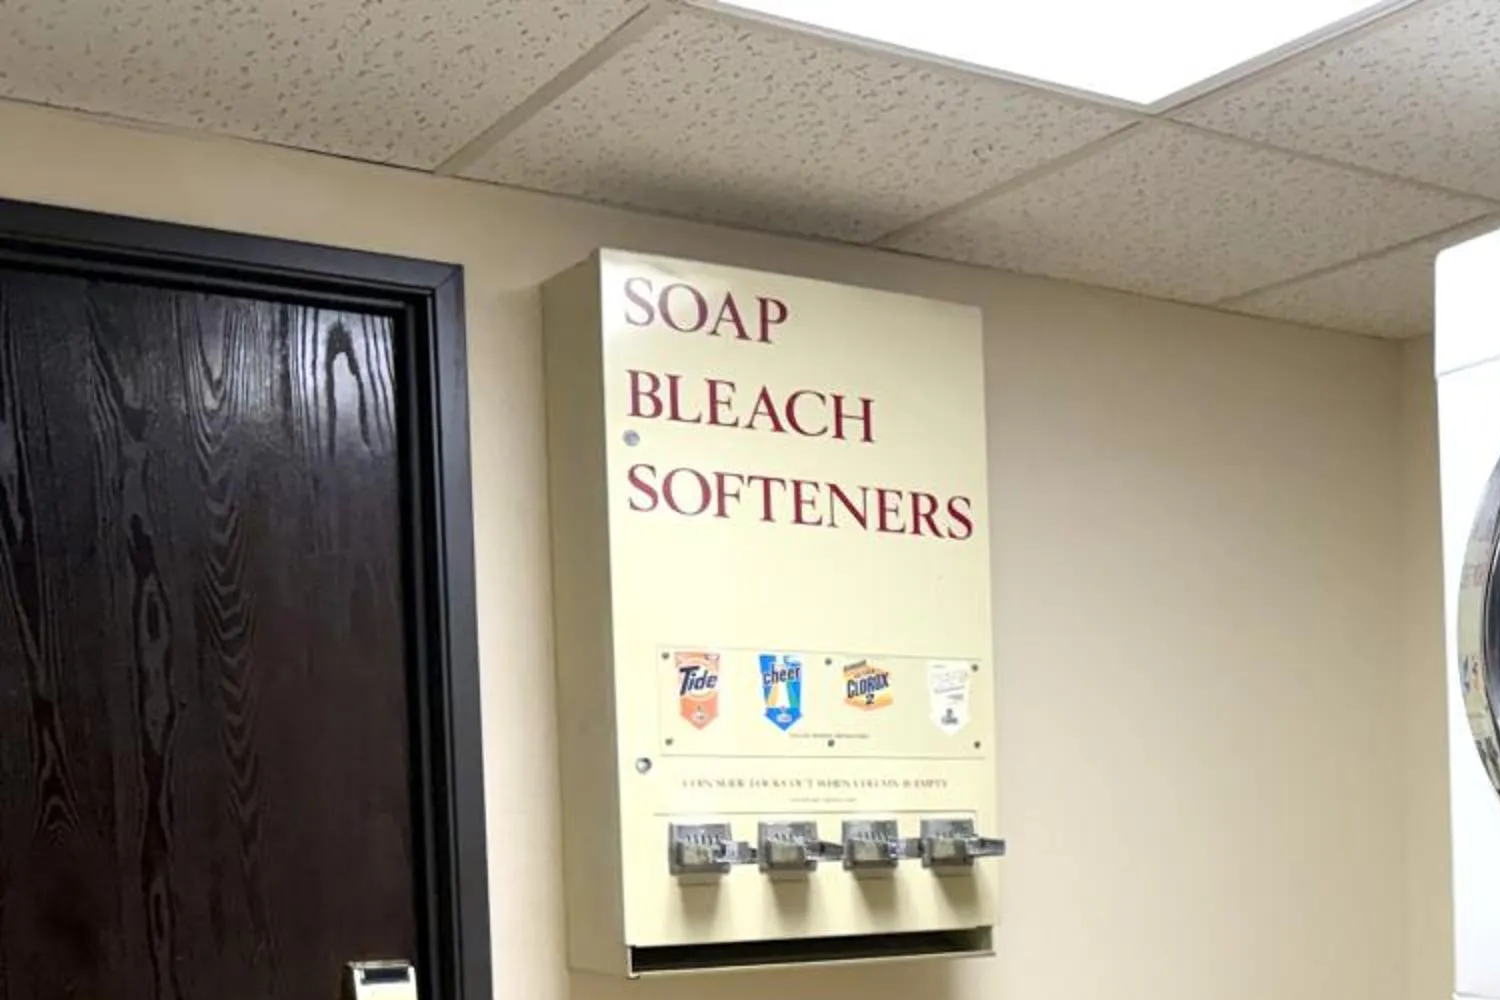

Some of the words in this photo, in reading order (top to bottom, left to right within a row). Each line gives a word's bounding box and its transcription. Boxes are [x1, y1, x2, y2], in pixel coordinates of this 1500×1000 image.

[623, 276, 788, 345] SOAP
[625, 369, 875, 443] BLEACH
[626, 463, 974, 541] SOFTENERS
[679, 665, 719, 696] Tide
